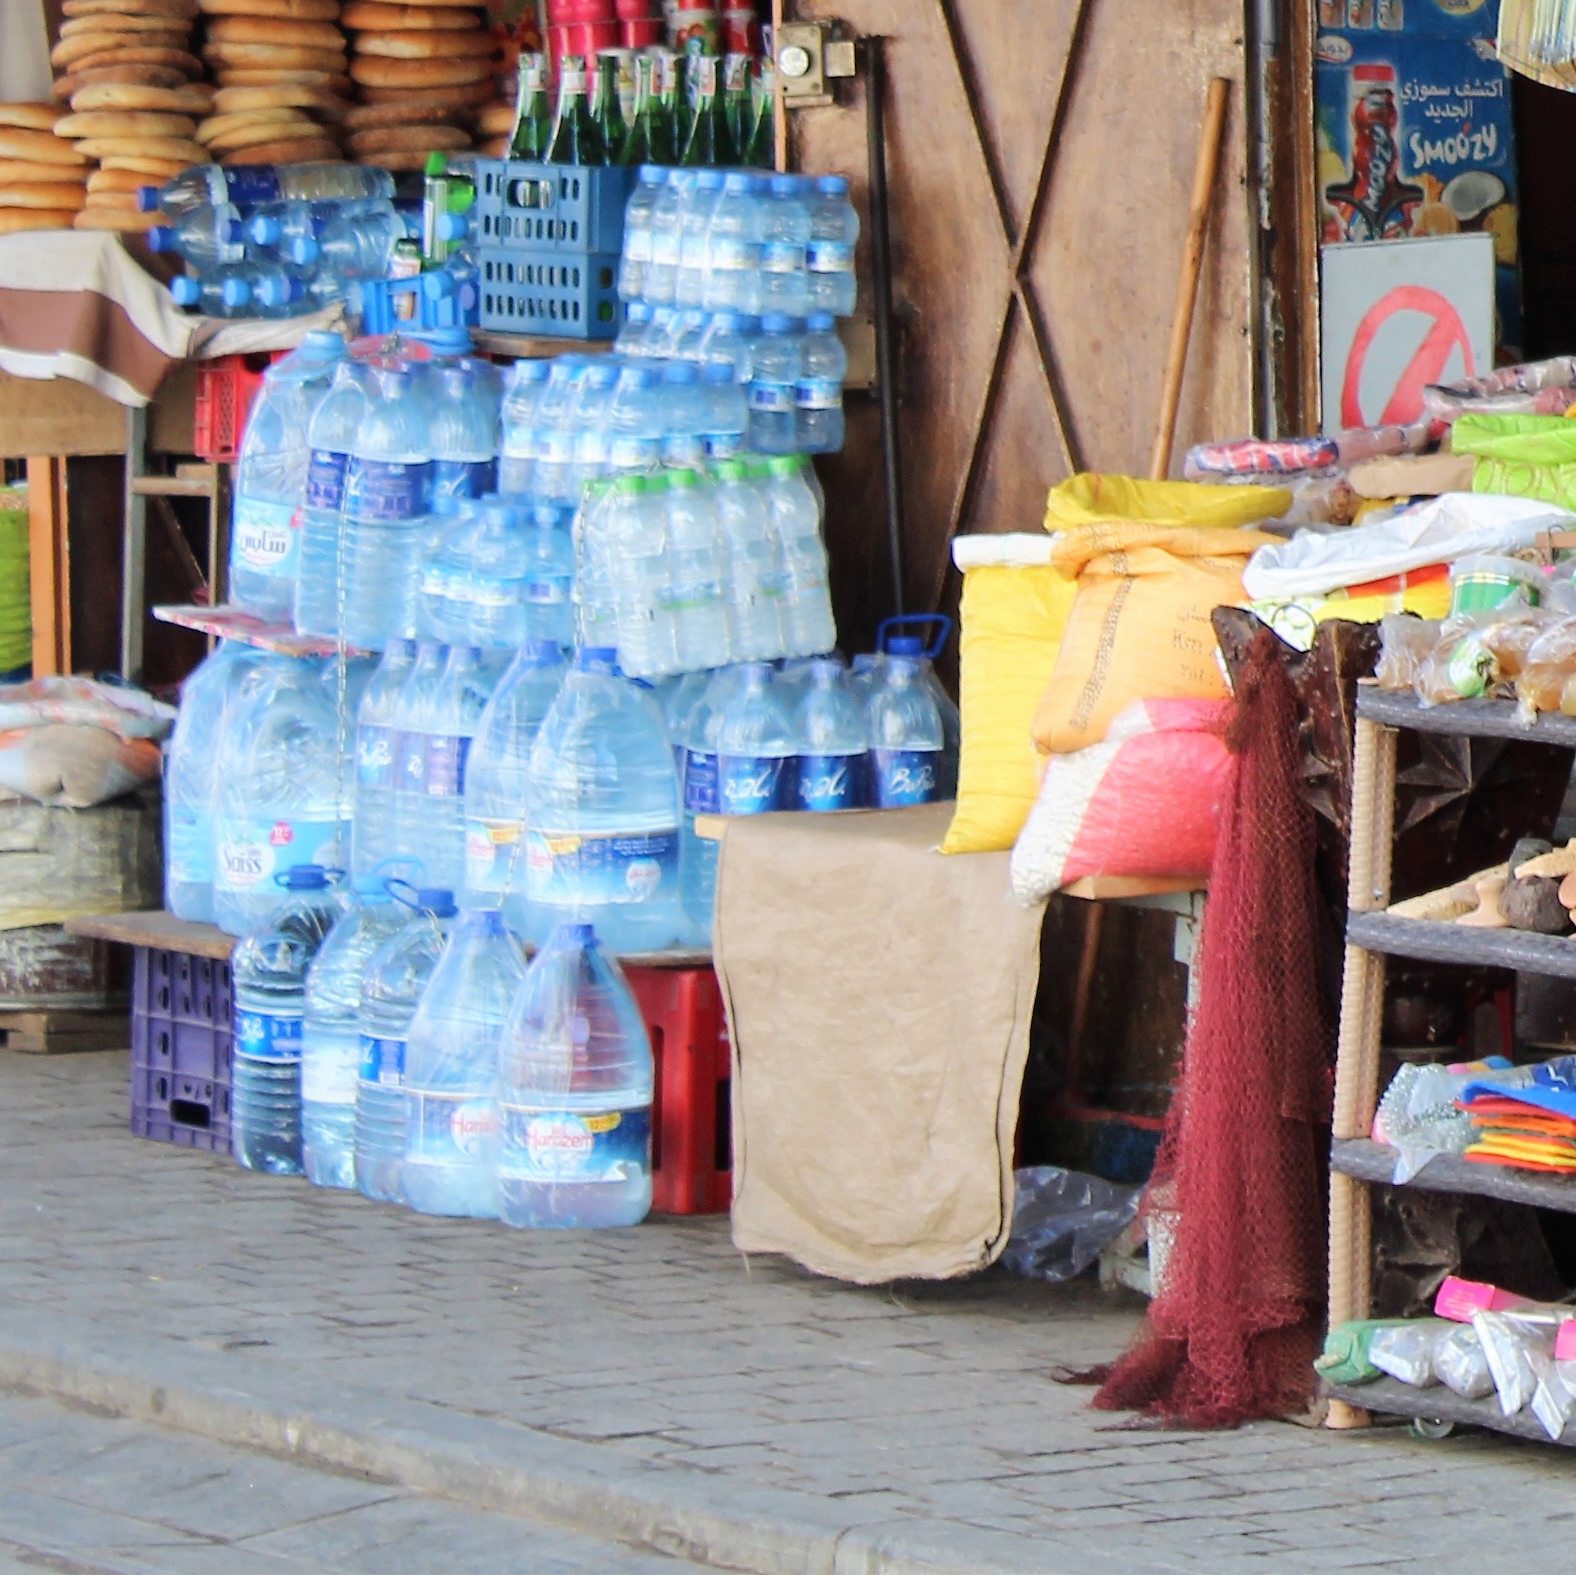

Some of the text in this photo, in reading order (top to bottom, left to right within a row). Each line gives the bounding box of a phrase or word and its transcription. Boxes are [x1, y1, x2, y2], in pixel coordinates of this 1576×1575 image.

[1400, 78, 1504, 105] اكتشف سموزي
[1424, 99, 1474, 124] الجديد
[1408, 122, 1498, 170] SMOOZY
